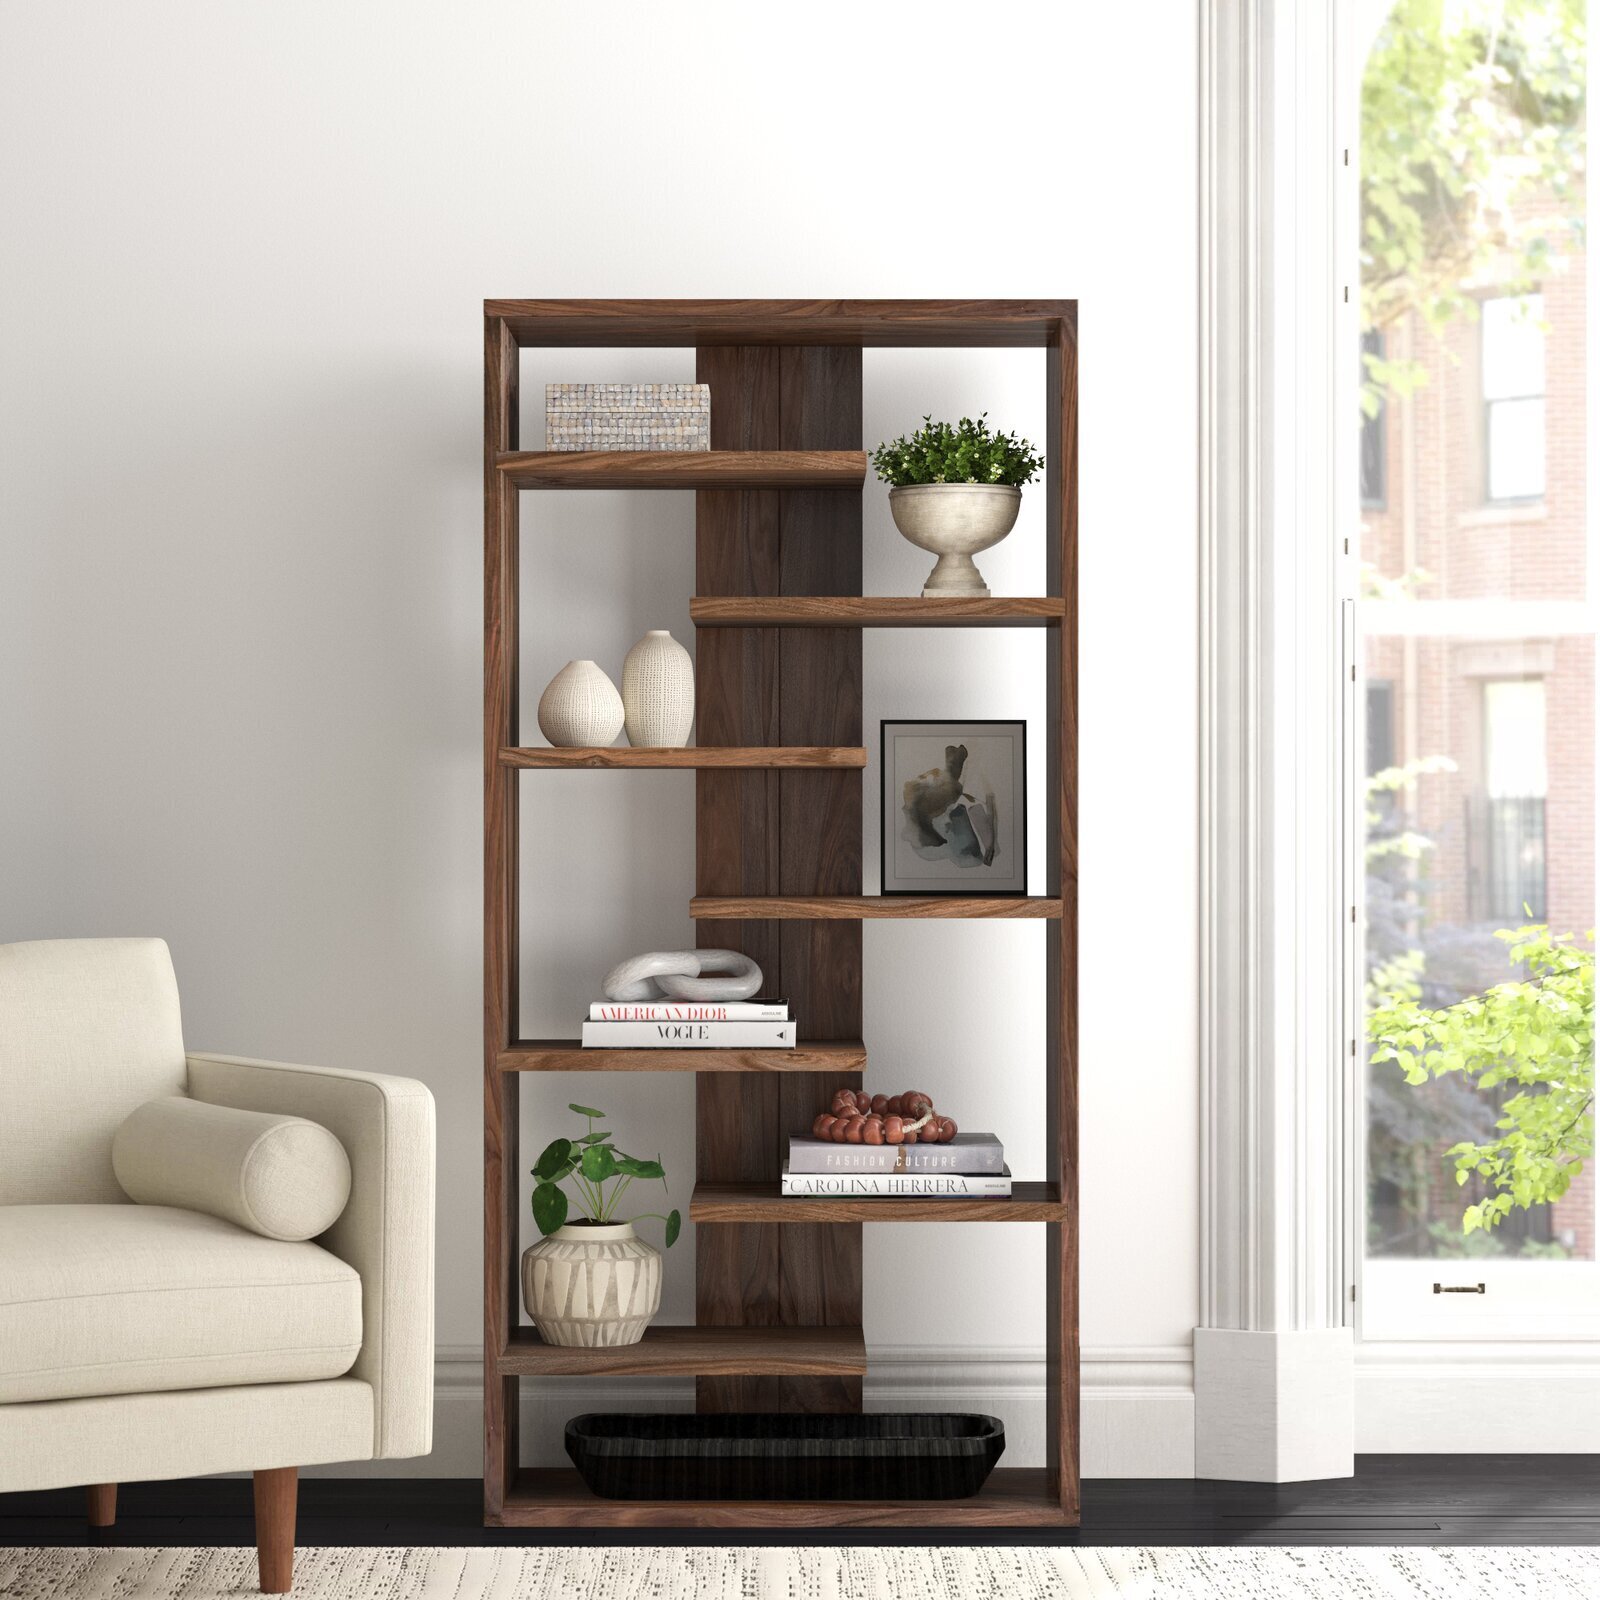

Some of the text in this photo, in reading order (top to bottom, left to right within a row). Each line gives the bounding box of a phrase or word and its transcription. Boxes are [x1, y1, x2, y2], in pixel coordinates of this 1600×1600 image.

[600, 1007, 727, 1020] AMERICAN DIOR
[657, 1025, 709, 1040] VOGUE
[826, 1155, 958, 1167] FASHION CULTURE
[790, 1179, 968, 1193] CAROLINA HERRERA
